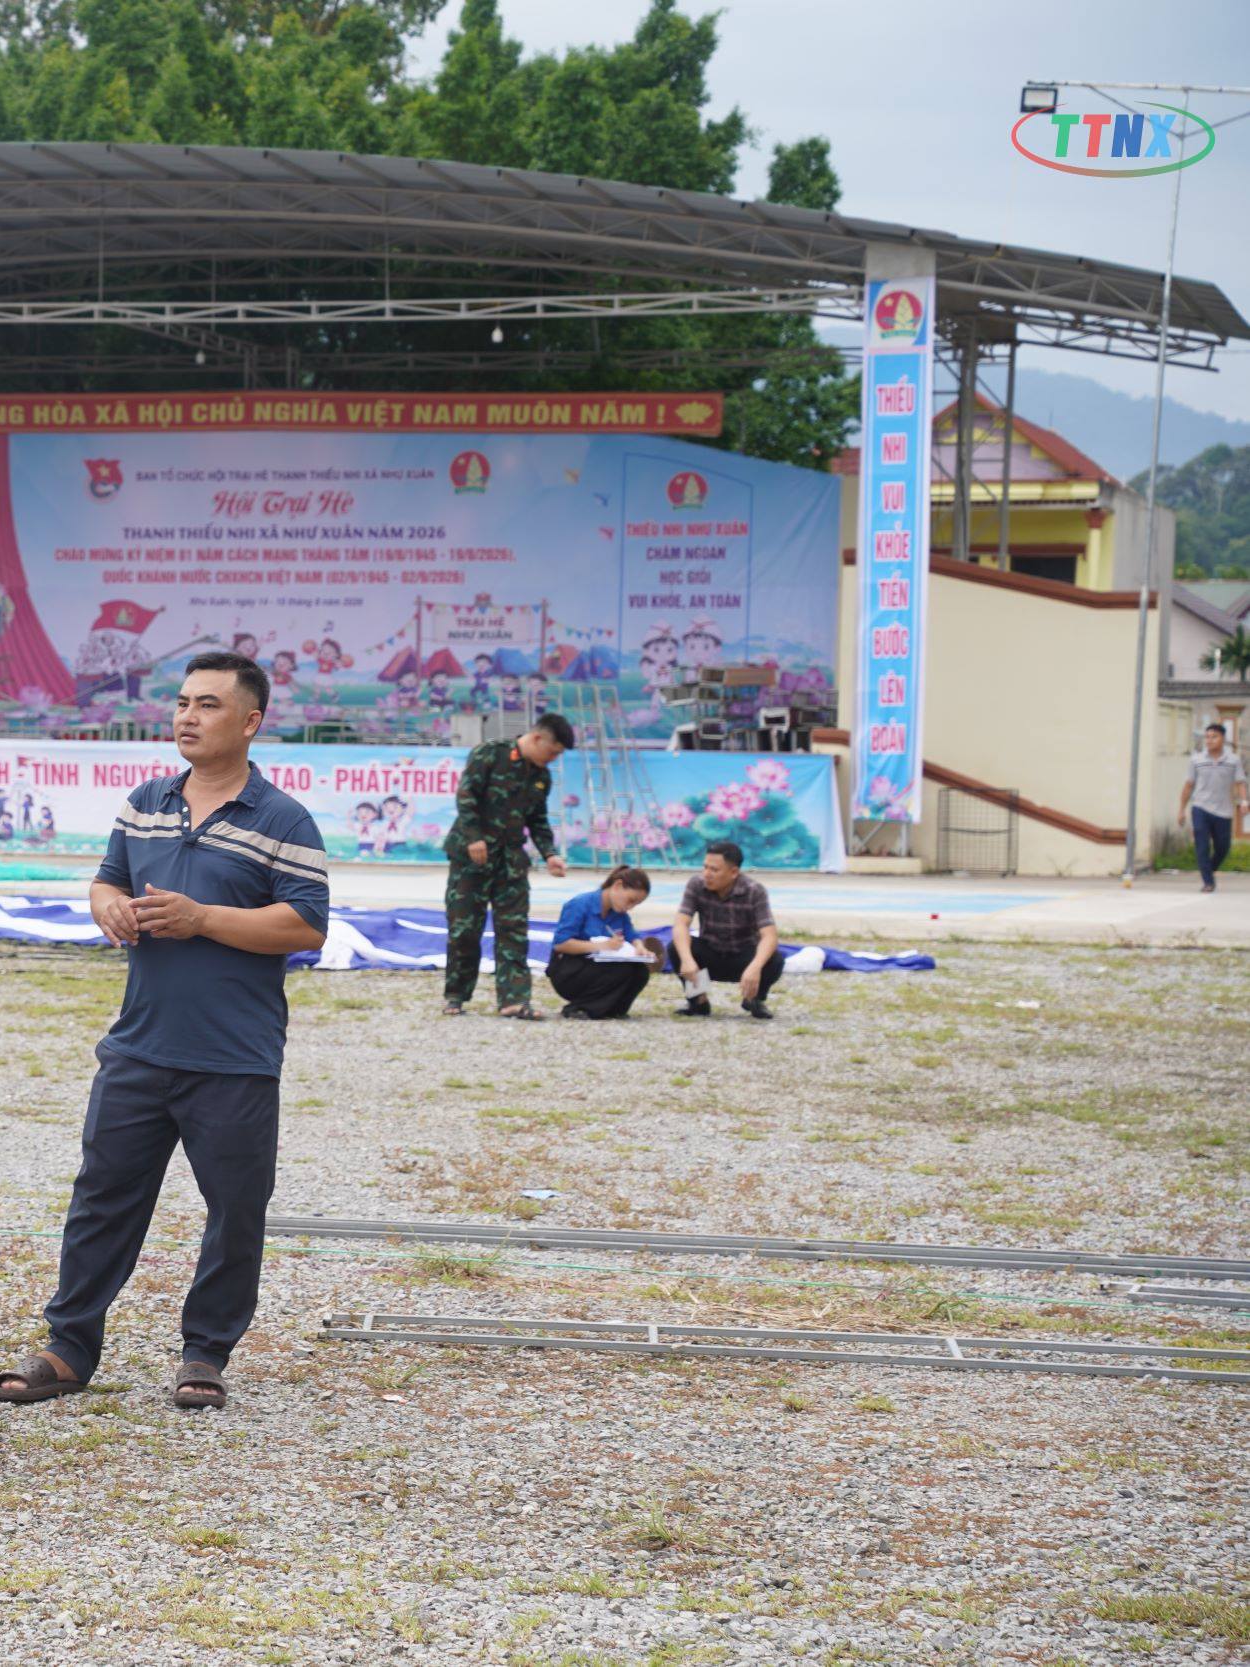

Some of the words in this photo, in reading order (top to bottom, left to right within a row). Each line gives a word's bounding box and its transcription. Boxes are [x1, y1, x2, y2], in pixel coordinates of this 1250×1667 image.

[877, 375, 915, 416] THIẾU
[33, 400, 86, 424] HÒA
[95, 400, 130, 424] XÃ
[138, 400, 183, 428] HỘI
[191, 397, 246, 423] CHỦ
[253, 399, 338, 423] NGHĨA
[346, 400, 405, 428] VIỆT
[413, 403, 478, 425] NAM
[486, 401, 571, 425] MUÔN
[580, 400, 647, 425] NĂM
[882, 434, 907, 464] NHI
[272, 470, 307, 480] THANH
[213, 489, 257, 518] Hội
[262, 489, 313, 519] Trại
[318, 489, 355, 518] Hè
[882, 483, 906, 513] VUI
[123, 527, 175, 539] THANH
[179, 521, 223, 539] THIẾU
[227, 527, 255, 539] NHI
[259, 523, 280, 539] XÃ
[282, 526, 318, 539] NHƯ
[321, 524, 364, 539] XUÂN
[367, 524, 403, 539] NĂM
[408, 526, 446, 539] 2026
[875, 522, 911, 560] KHỎE
[227, 546, 259, 561] CÁCH
[302, 547, 340, 561] THÁNG
[685, 546, 726, 560] NGOAN
[180, 567, 212, 584] NƯỚC
[266, 568, 292, 586] VIỆT
[295, 570, 323, 584] NAM
[879, 572, 909, 609] TIẾN
[629, 594, 648, 608] VUI
[689, 594, 706, 608] AN
[710, 592, 741, 608] TOÀN
[873, 624, 909, 658] BƯỚC
[879, 670, 905, 705] LÊN
[32, 758, 78, 786] TÌNH
[335, 762, 392, 793] PHÁT
